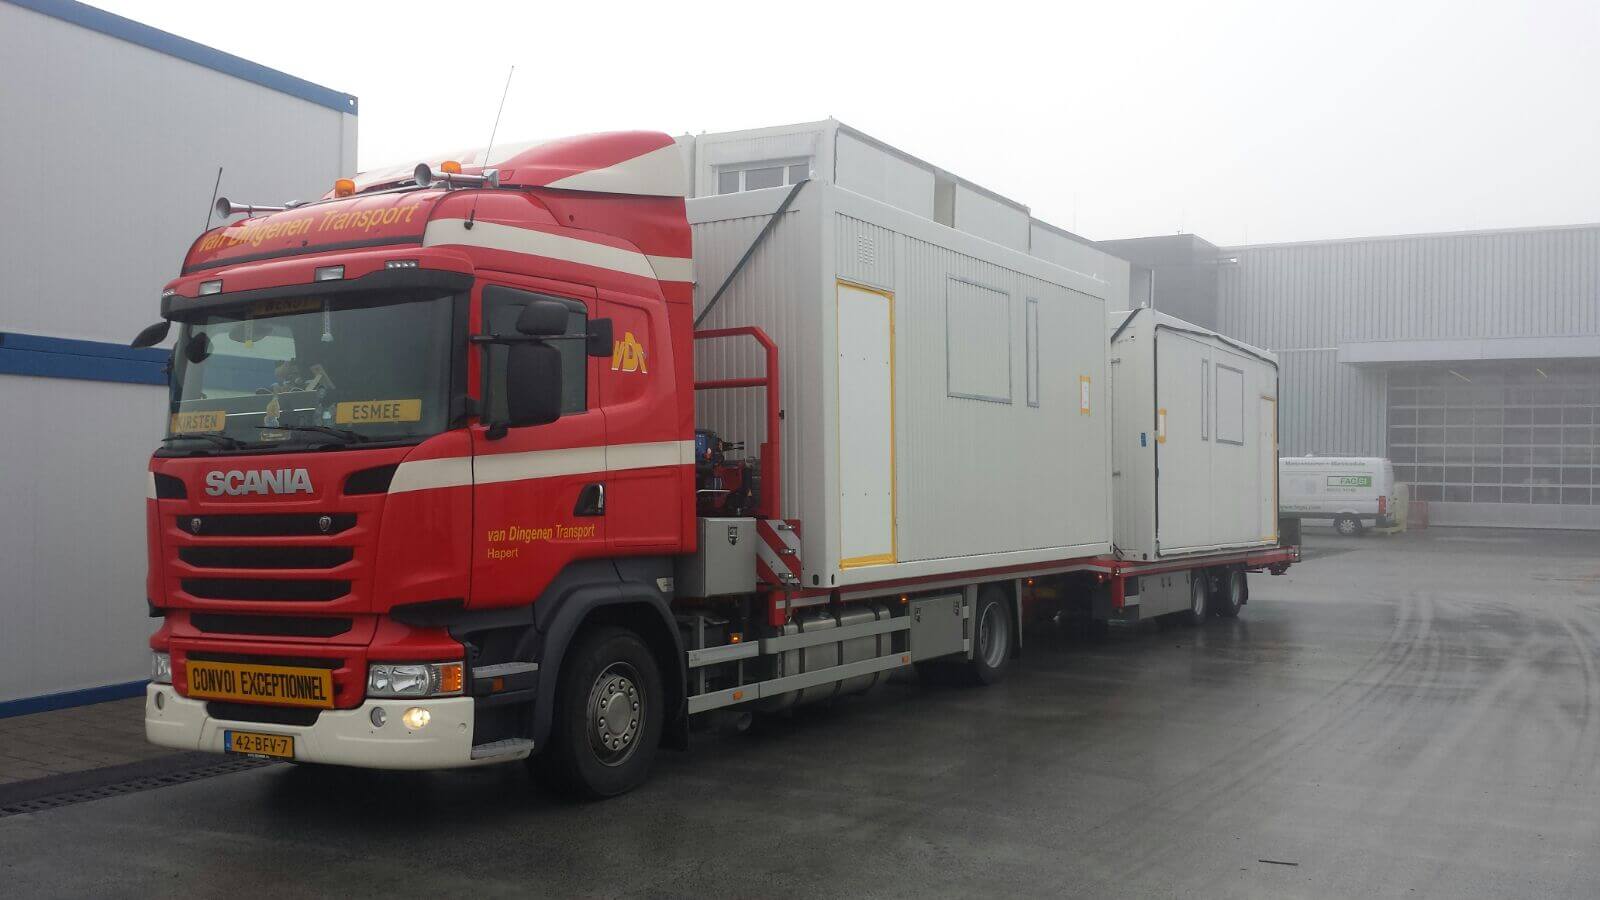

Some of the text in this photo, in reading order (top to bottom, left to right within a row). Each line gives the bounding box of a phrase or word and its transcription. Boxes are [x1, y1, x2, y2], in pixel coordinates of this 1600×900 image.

[198, 203, 419, 252] van Dingenen Transport
[352, 403, 401, 420] ESMEE
[175, 414, 217, 431] KIRSTEN
[205, 468, 314, 496] SCANIA
[487, 524, 595, 544] van Dingenen Transport
[487, 547, 519, 560] Hapert
[192, 667, 327, 701] CONVOI EXCEPTIONNEL
[235, 734, 288, 754] 42-BFV-7
